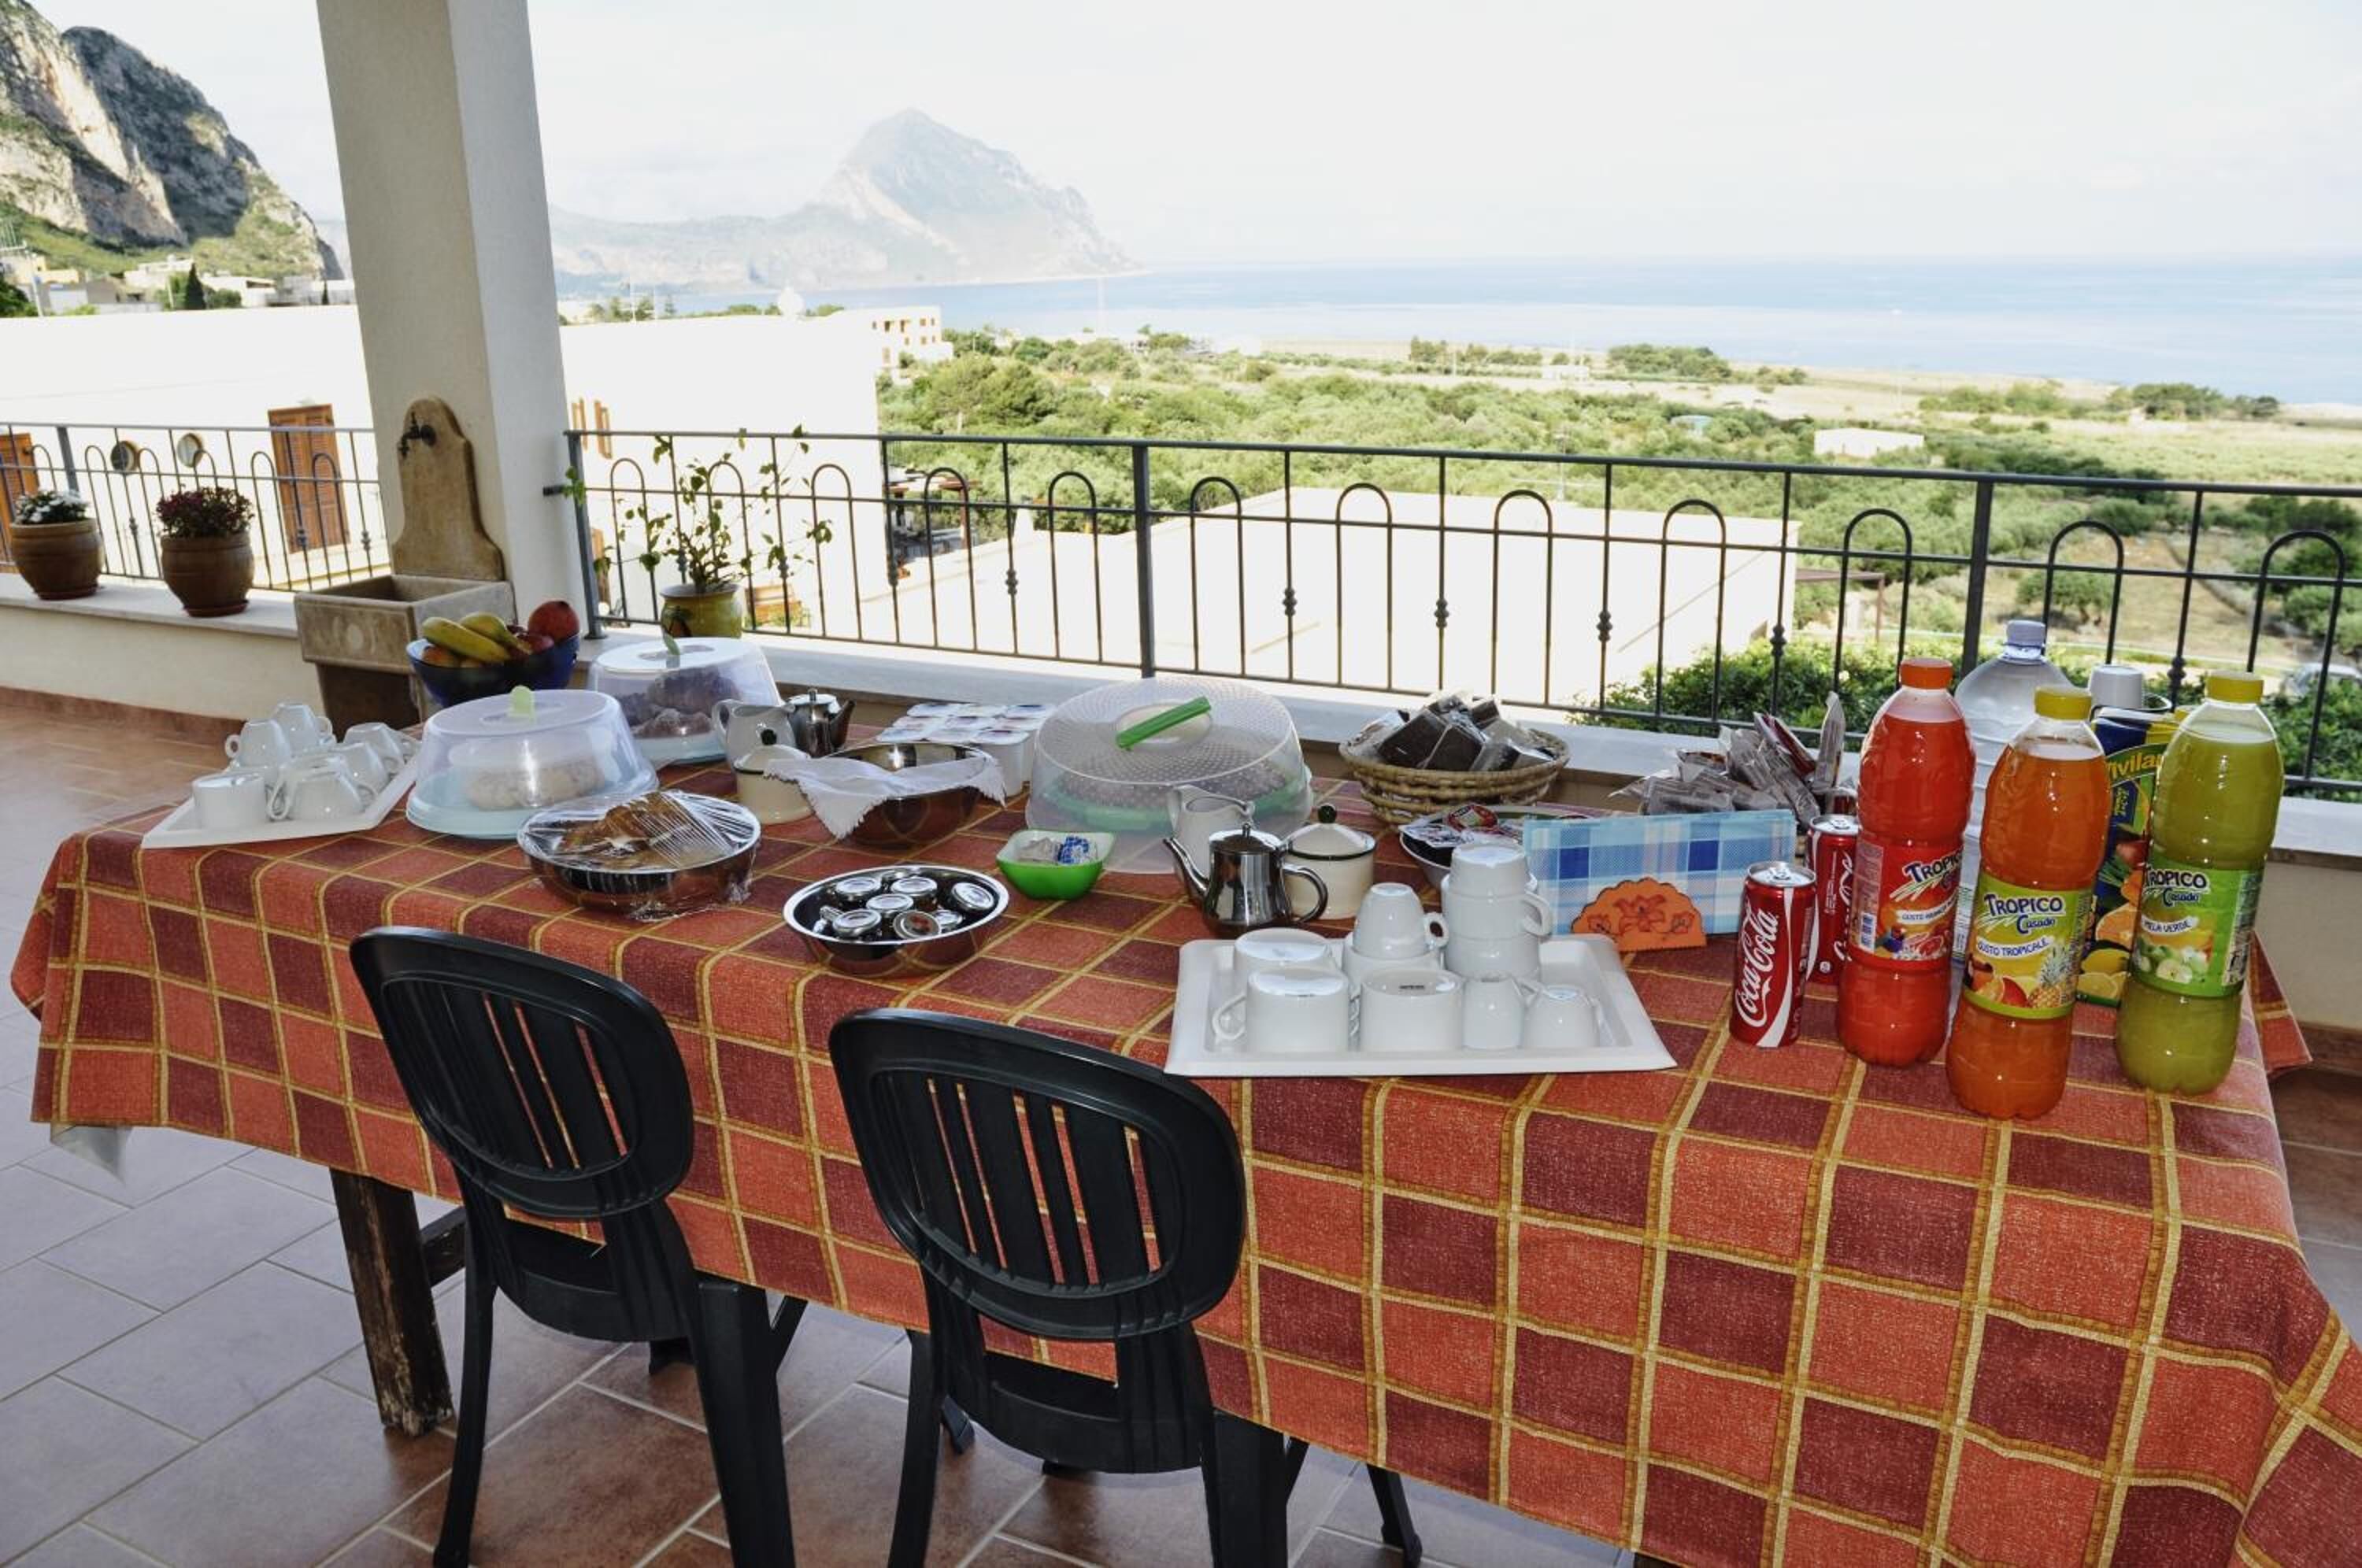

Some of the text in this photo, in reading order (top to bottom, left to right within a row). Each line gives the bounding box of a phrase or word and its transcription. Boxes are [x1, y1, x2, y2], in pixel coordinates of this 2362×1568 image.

[1983, 893, 2063, 916] TROPICO
[1977, 937, 2049, 956] GUSTO TROPICALE
